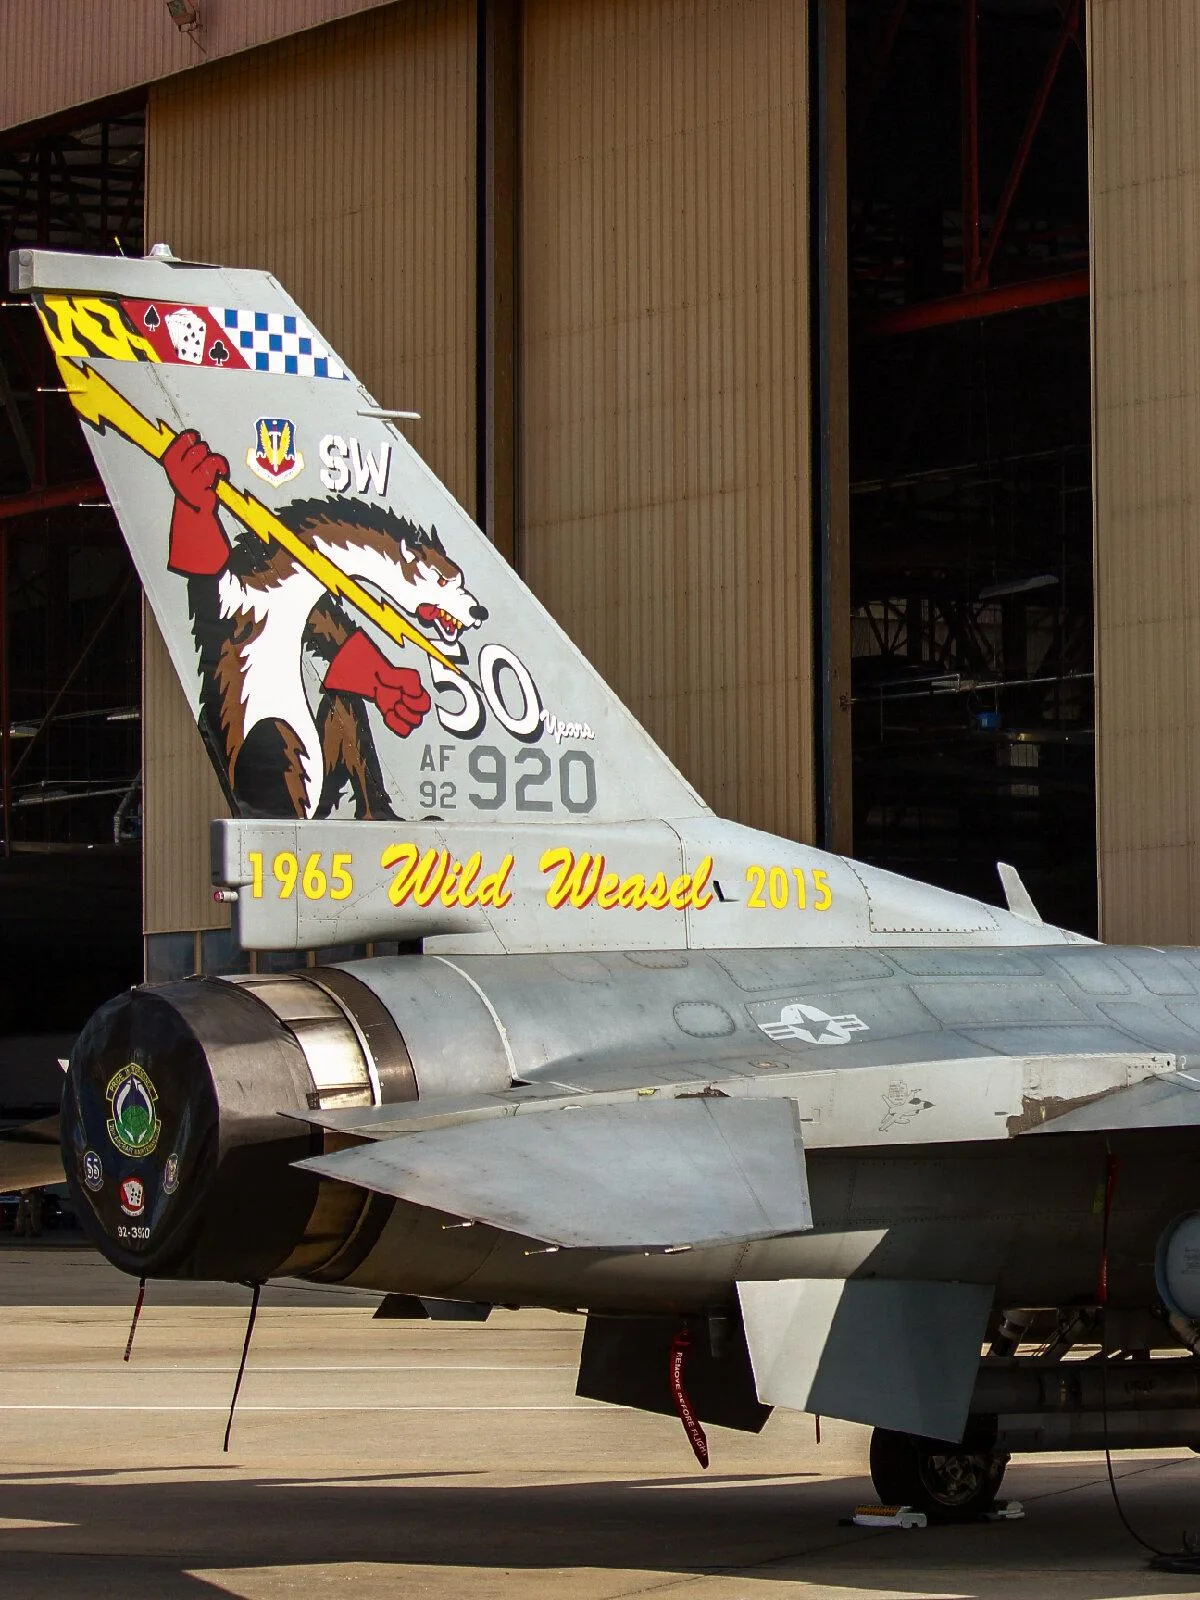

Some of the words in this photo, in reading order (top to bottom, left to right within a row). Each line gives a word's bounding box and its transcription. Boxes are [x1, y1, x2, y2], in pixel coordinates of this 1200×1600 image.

[319, 434, 393, 497] SW
[427, 638, 545, 744] 50
[540, 708, 596, 744] Years
[420, 744, 456, 772] AF
[419, 780, 457, 809] 92
[468, 745, 598, 813] 920
[248, 851, 353, 901] 1965
[380, 841, 515, 909] Wild
[539, 846, 714, 912] Weasel
[744, 864, 833, 912] 2015
[674, 1352, 683, 1390] REMOVE
[677, 1392, 695, 1428] BEFORE
